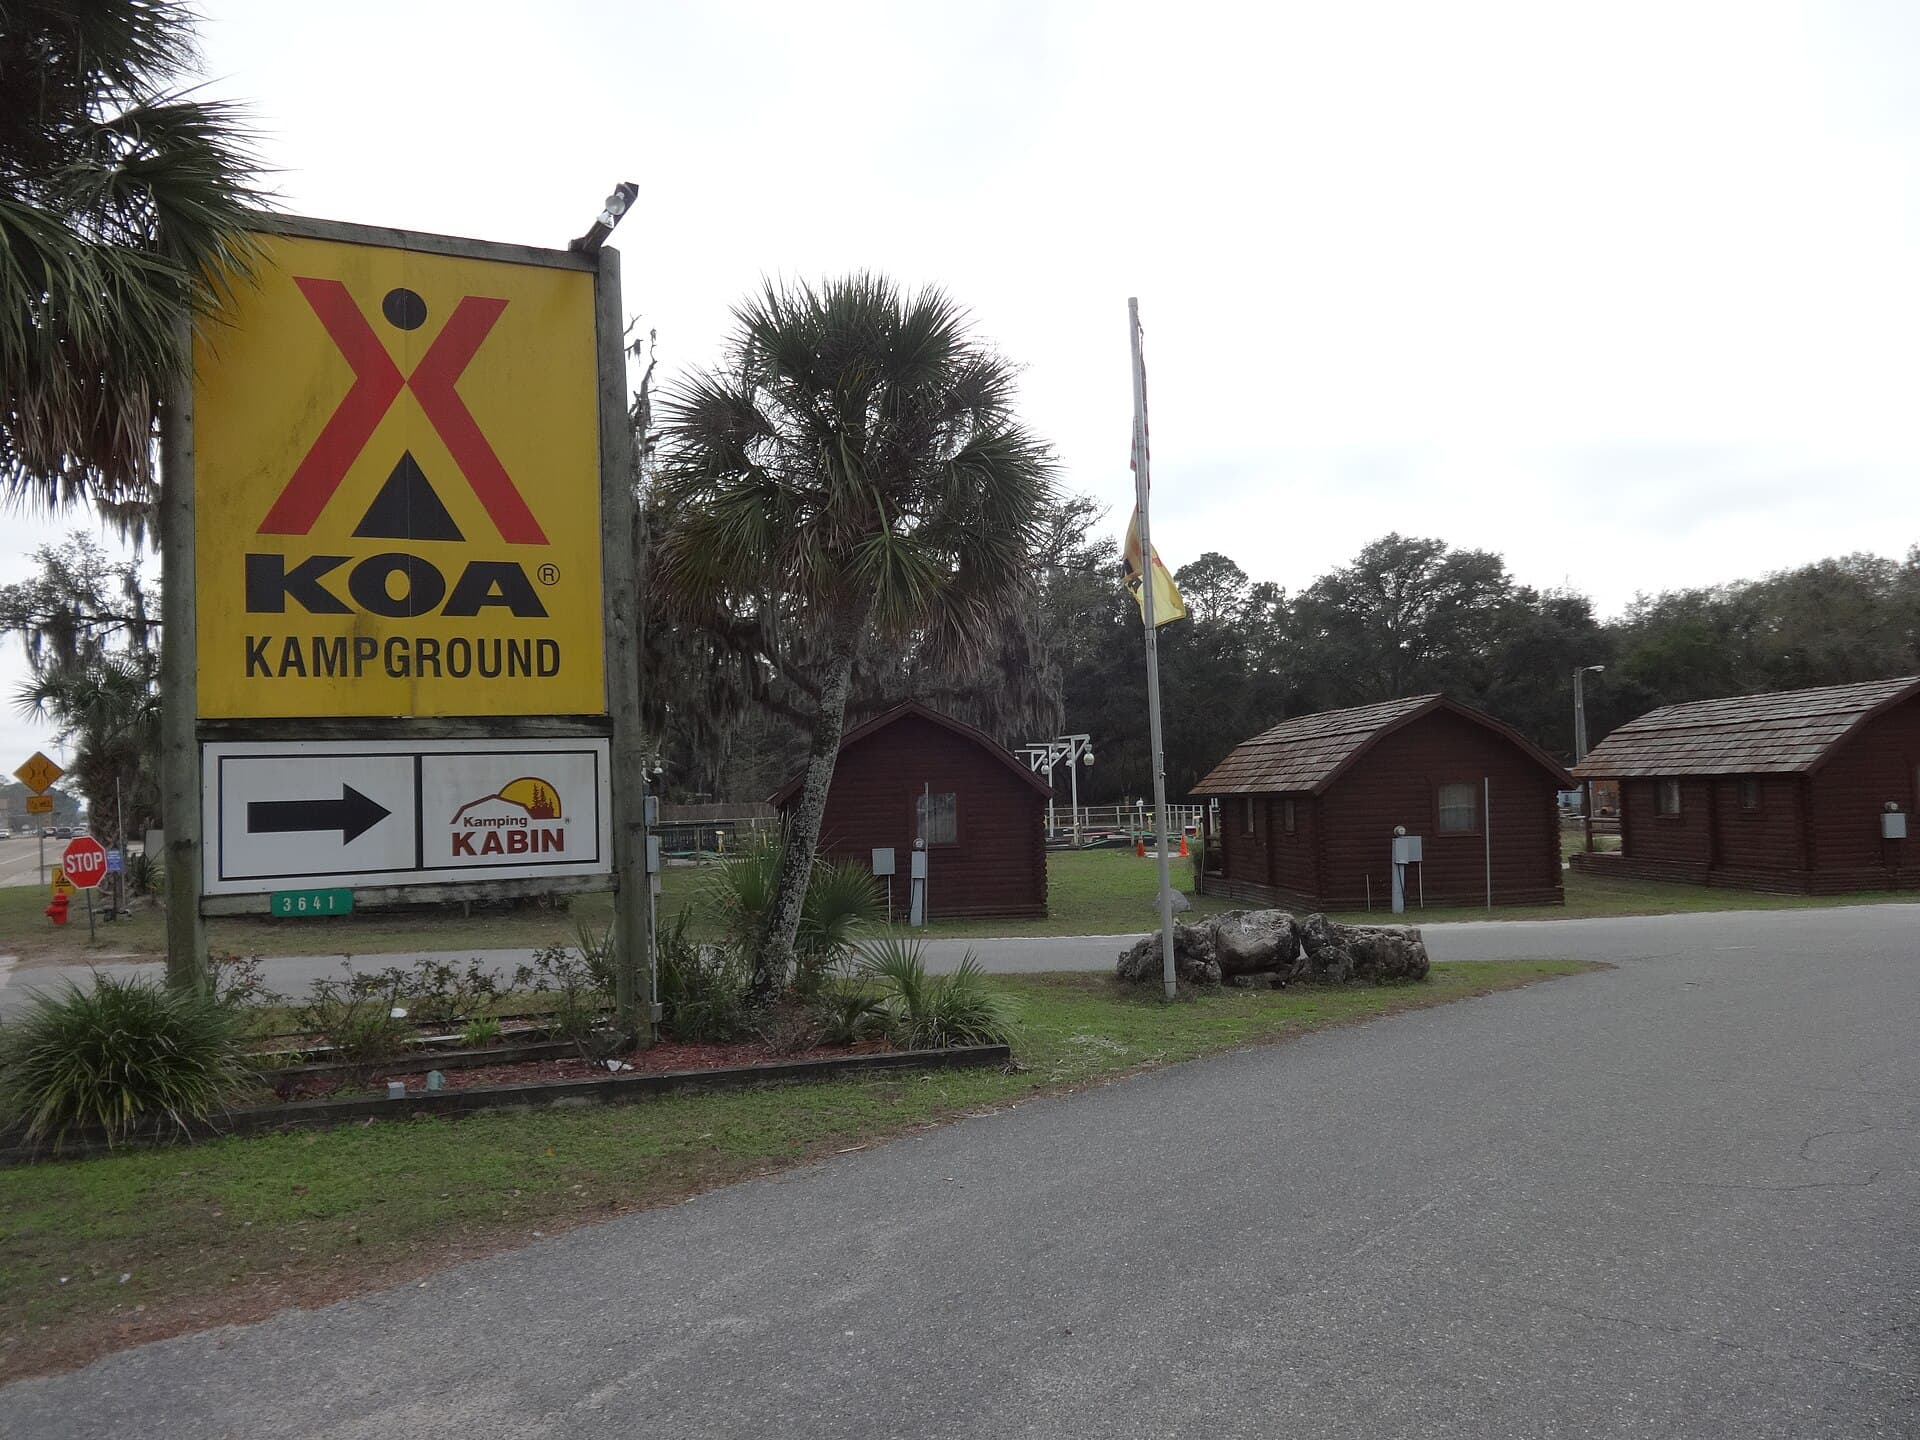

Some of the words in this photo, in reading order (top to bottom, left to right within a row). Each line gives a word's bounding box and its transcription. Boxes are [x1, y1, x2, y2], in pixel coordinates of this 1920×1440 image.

[245, 552, 549, 618] KOA
[245, 636, 561, 679] KAMPGROUND
[463, 815, 528, 829] Kamping
[452, 829, 564, 857] KABIN
[66, 851, 103, 874] STOP
[282, 895, 335, 912] 3641
